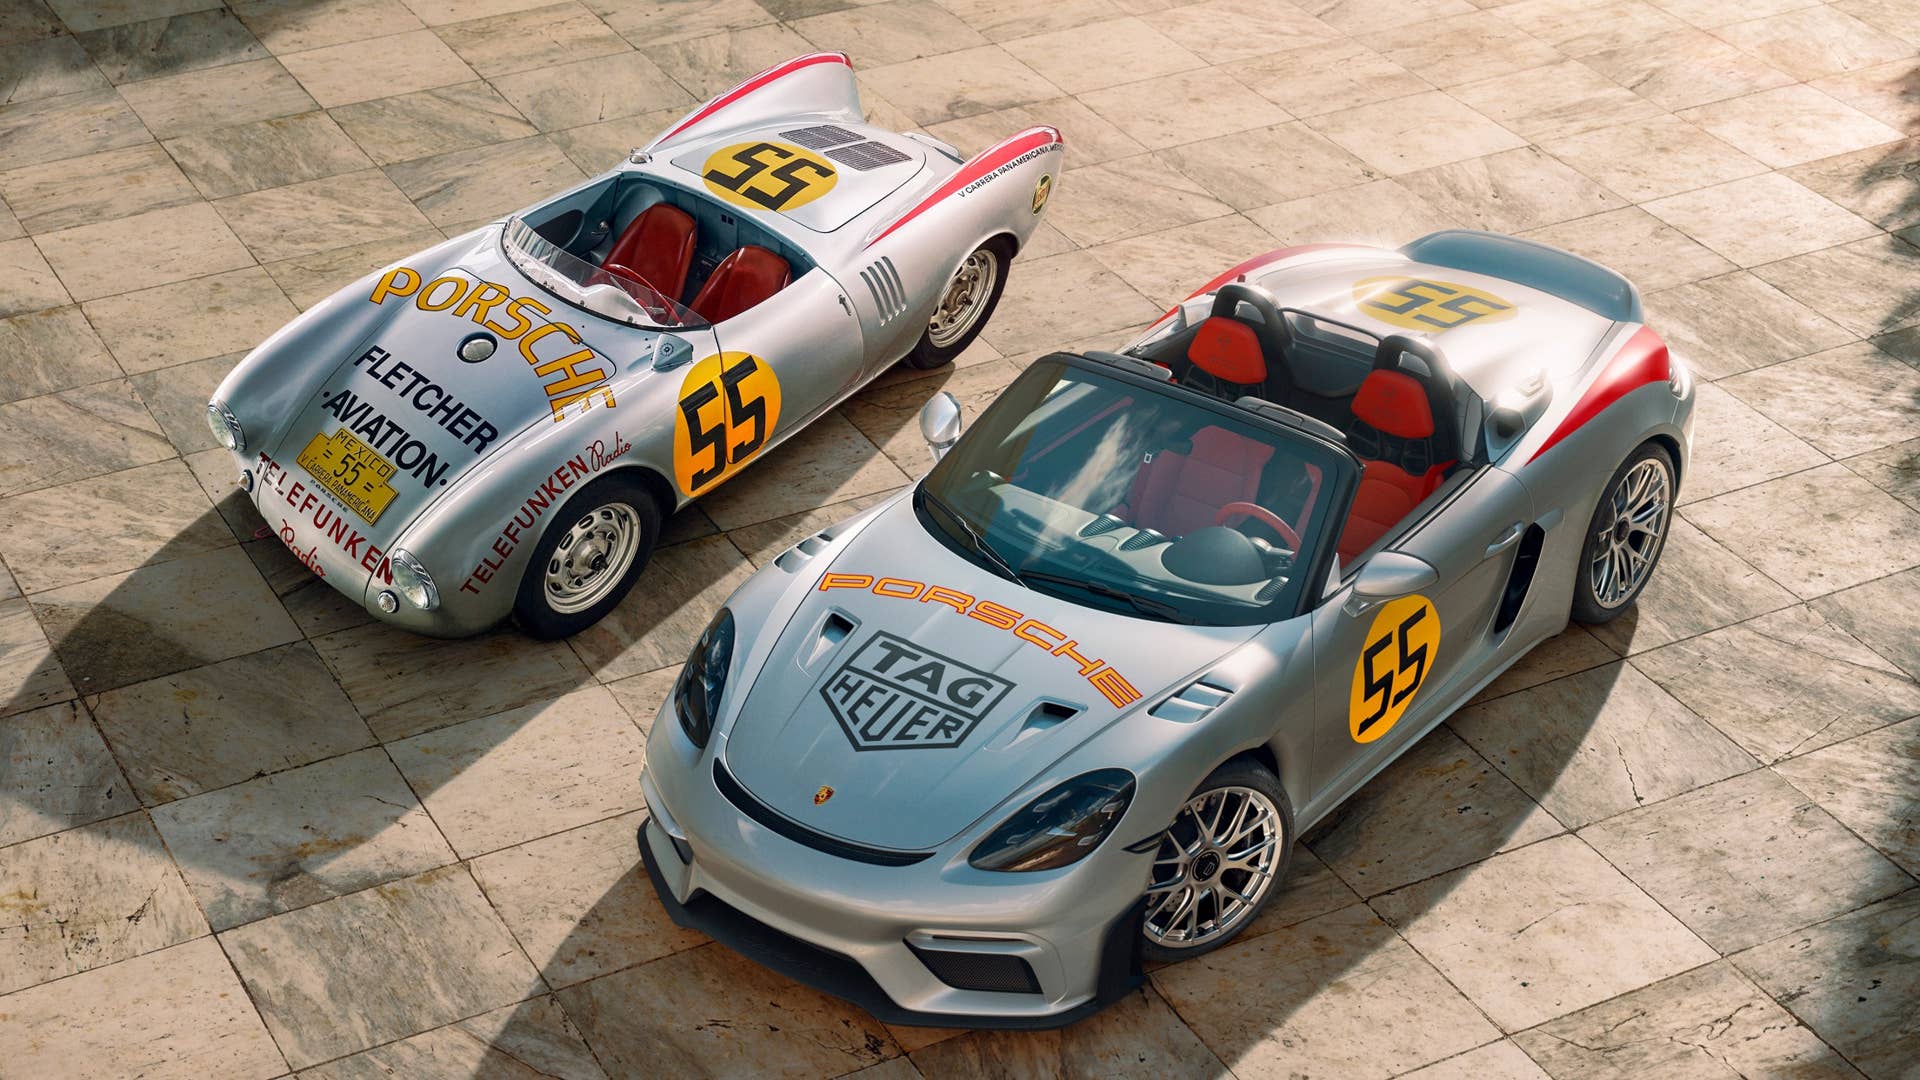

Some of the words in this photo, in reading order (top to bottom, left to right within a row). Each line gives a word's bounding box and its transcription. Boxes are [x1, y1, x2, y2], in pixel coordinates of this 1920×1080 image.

[703, 143, 836, 211] 55
[965, 172, 1000, 194] CARRERA
[998, 147, 1049, 175] PANAMERICANA
[1363, 279, 1512, 329] 55
[369, 266, 617, 423] PORSCHE
[353, 345, 499, 454] FLETCHER
[679, 355, 758, 491] 55
[333, 453, 367, 486] 55
[336, 431, 391, 477] MEXICO
[256, 451, 393, 585] TELEFUNKEN
[306, 459, 332, 484] CARRERA
[332, 480, 376, 520] PANAMERICANA
[460, 454, 589, 595] TELEFUNKEN
[585, 431, 632, 472] Radio
[280, 518, 326, 577] Radio
[818, 572, 1143, 709] PORSCHE
[1358, 605, 1427, 736] 55
[833, 674, 965, 741] HEUER
[872, 641, 993, 708] TAG
